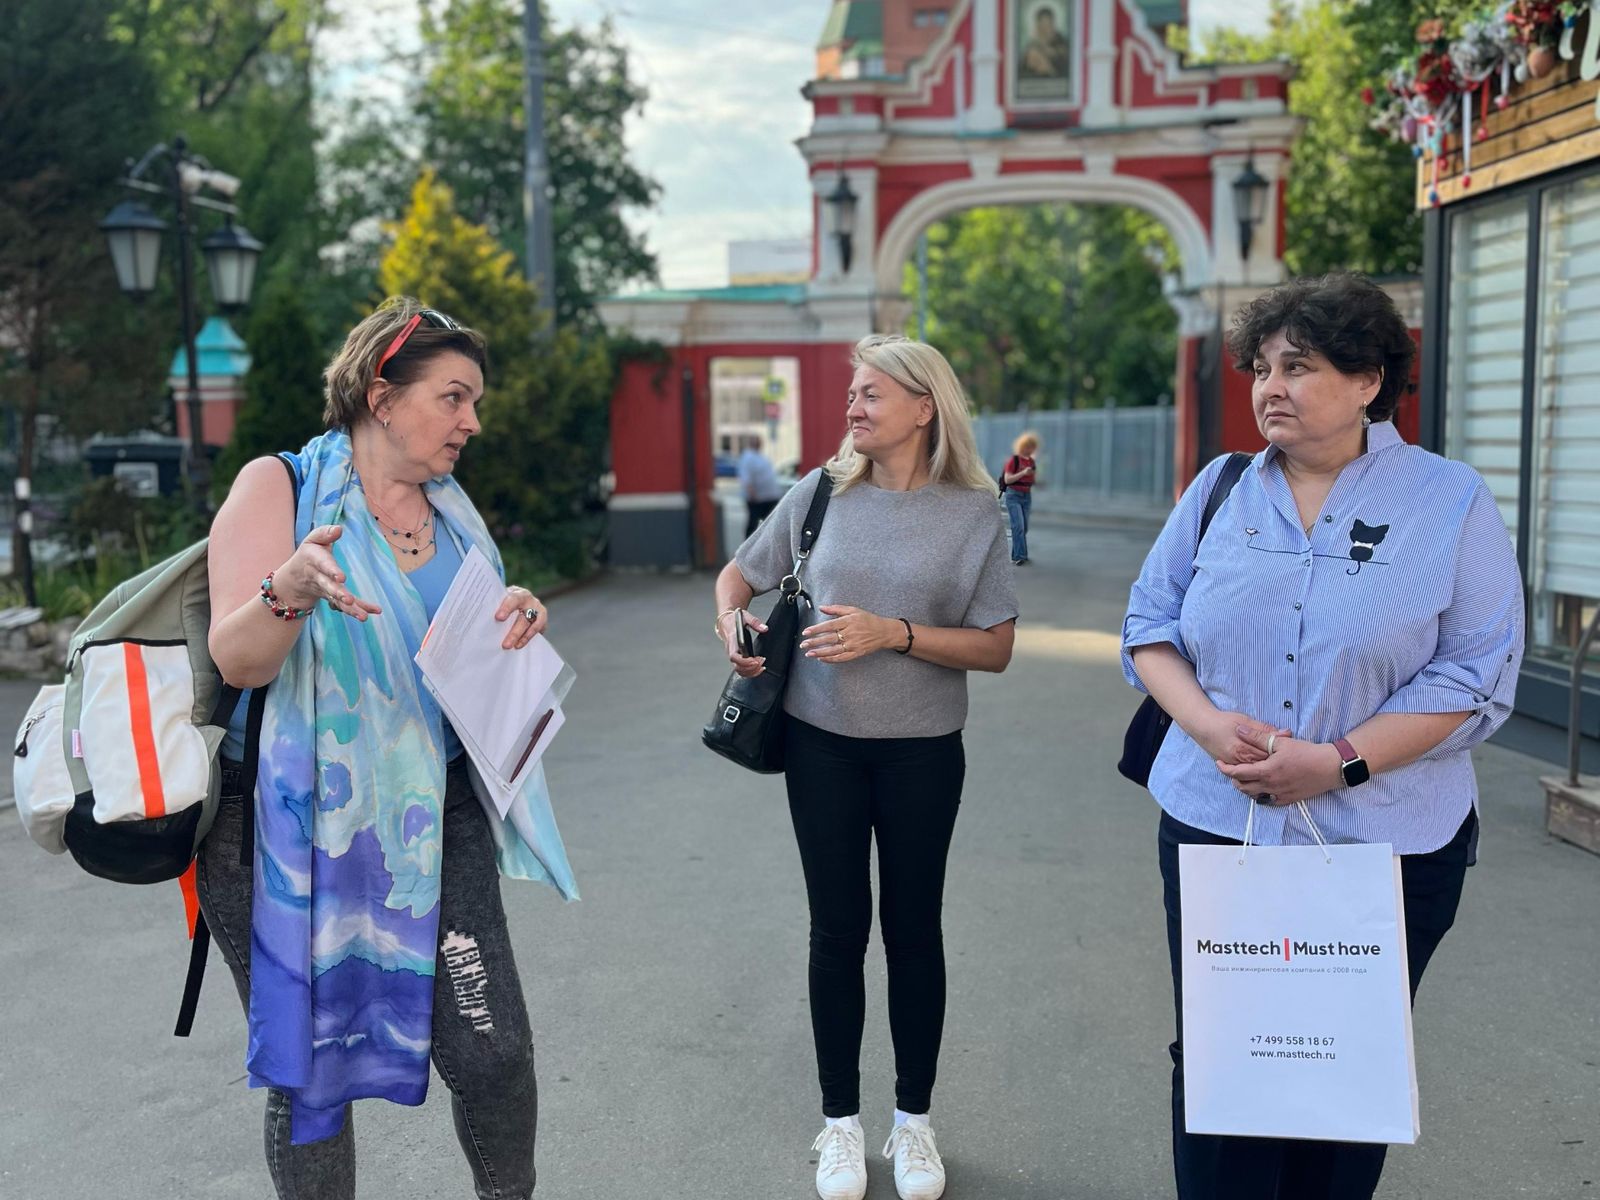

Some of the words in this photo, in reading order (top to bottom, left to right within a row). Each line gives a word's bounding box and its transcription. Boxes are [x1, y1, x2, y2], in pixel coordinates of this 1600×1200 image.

[1197, 939, 1281, 955] Masttech
[1293, 940, 1335, 956] Must
[1338, 941, 1381, 956] have
[1351, 967, 1368, 975] года
[1250, 1035, 1262, 1044] +7
[1265, 1036, 1283, 1045] 499
[1286, 1036, 1305, 1045] 558
[1308, 1037, 1319, 1046] 18
[1322, 1037, 1335, 1046] 67
[1250, 1050, 1336, 1060] www.masttech.ru
